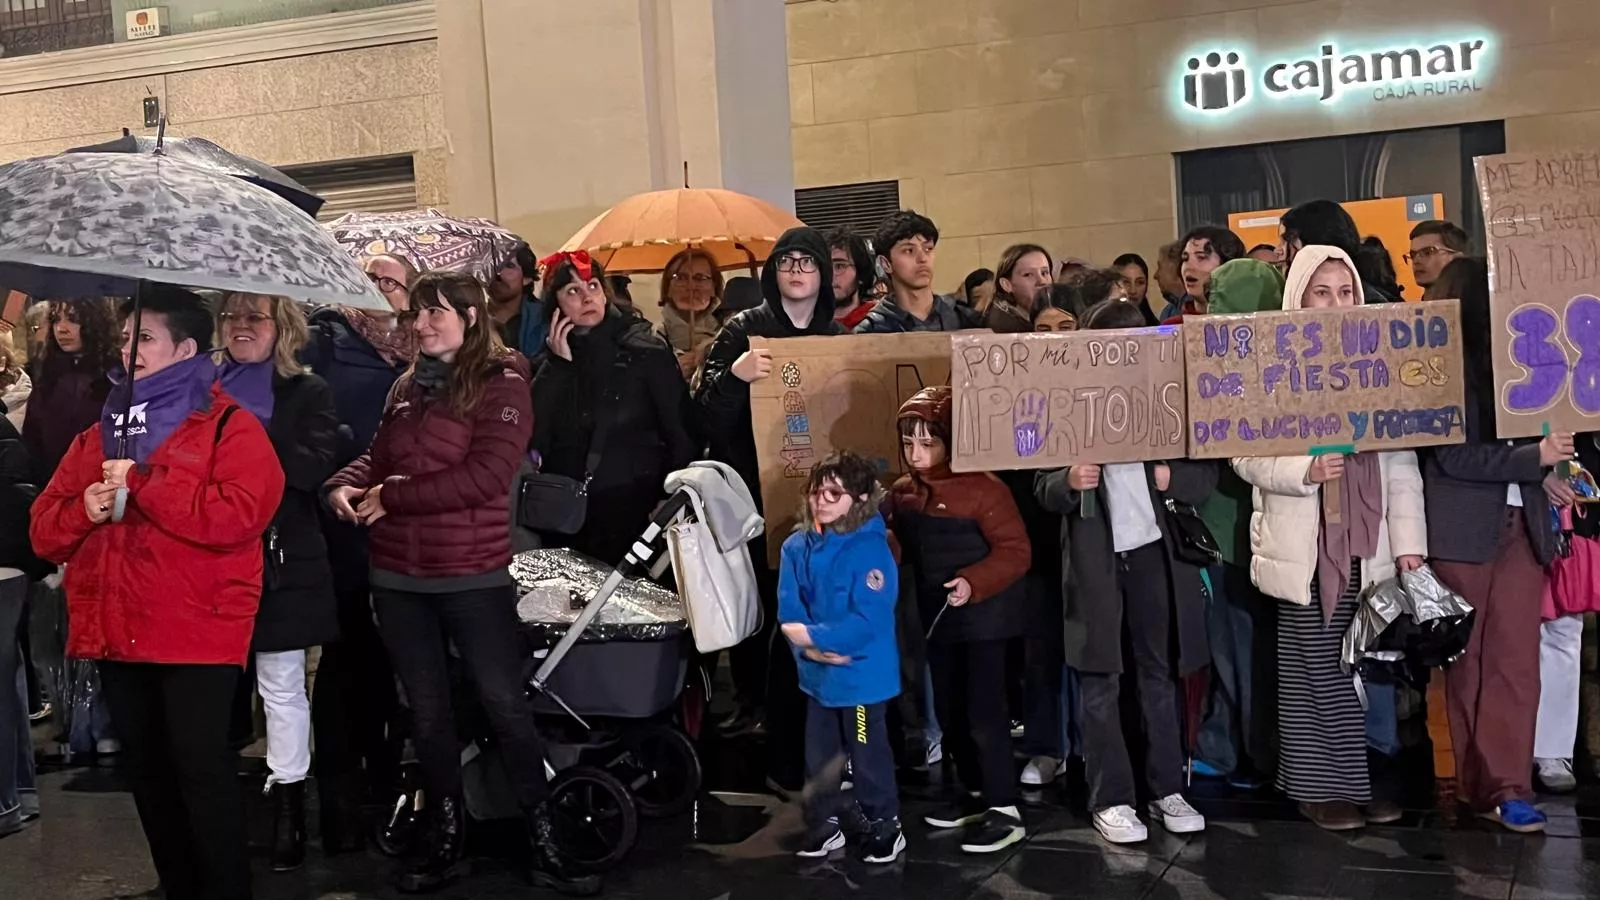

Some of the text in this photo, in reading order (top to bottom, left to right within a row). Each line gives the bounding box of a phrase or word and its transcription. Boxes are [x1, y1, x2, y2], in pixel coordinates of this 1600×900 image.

[1263, 39, 1484, 101] cajamar
[1372, 78, 1482, 101] CAJA RURAL
[1485, 161, 1528, 194] ME
[1275, 321, 1323, 360] ES
[1341, 316, 1379, 357] UN
[962, 342, 1030, 379] POR
[1086, 338, 1141, 367] POR
[1237, 412, 1342, 441] LUCHA
[1347, 410, 1369, 441] Y
